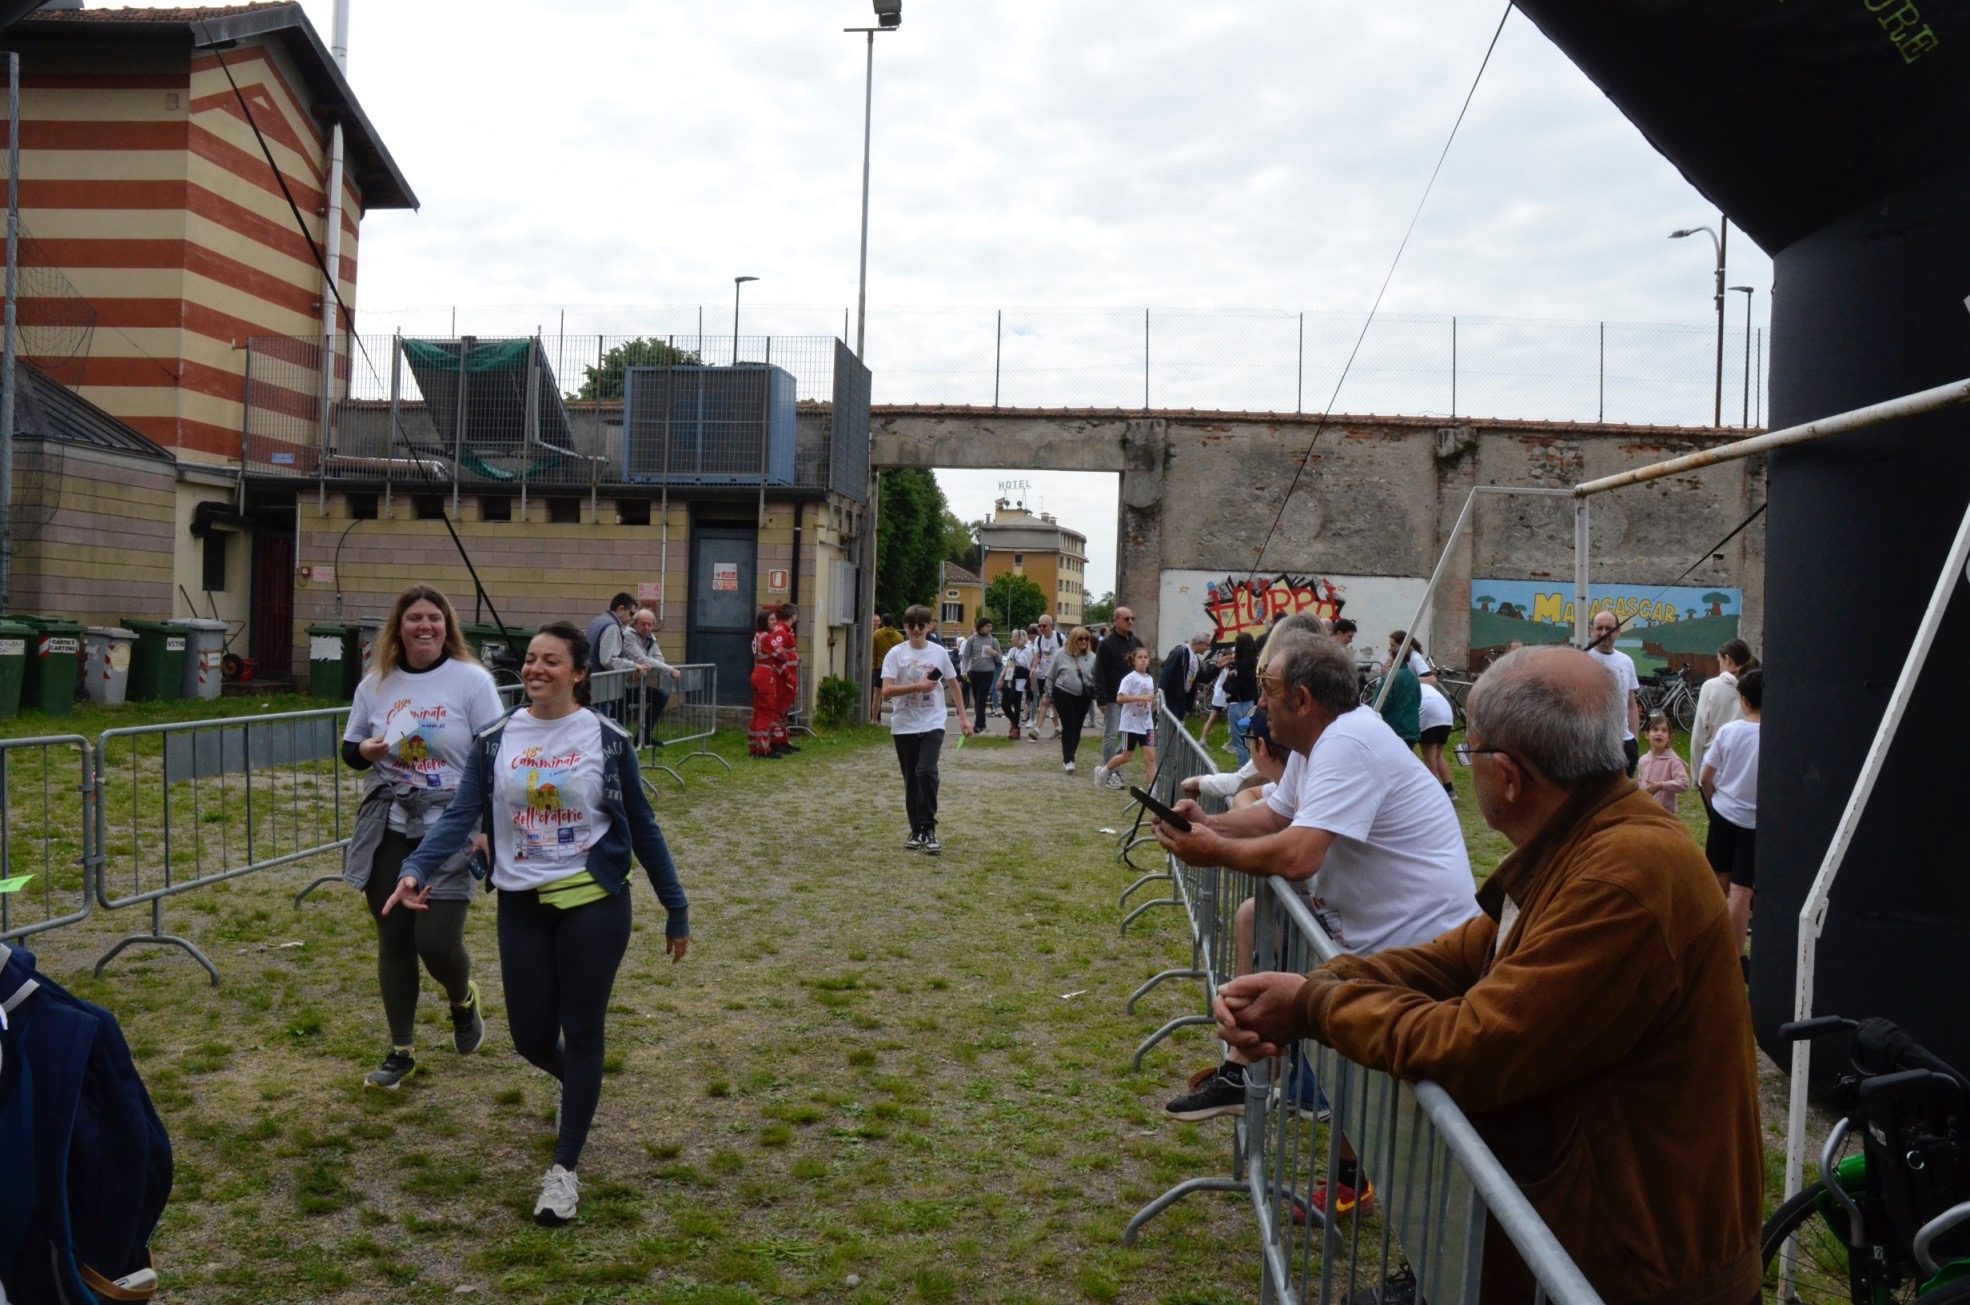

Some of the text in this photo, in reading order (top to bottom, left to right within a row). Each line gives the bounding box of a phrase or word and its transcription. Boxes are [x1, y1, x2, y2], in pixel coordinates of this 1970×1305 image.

[998, 479, 1032, 491] HOTEL
[1532, 592, 1677, 624] MAAGASCAR
[511, 752, 582, 770] Camminata
